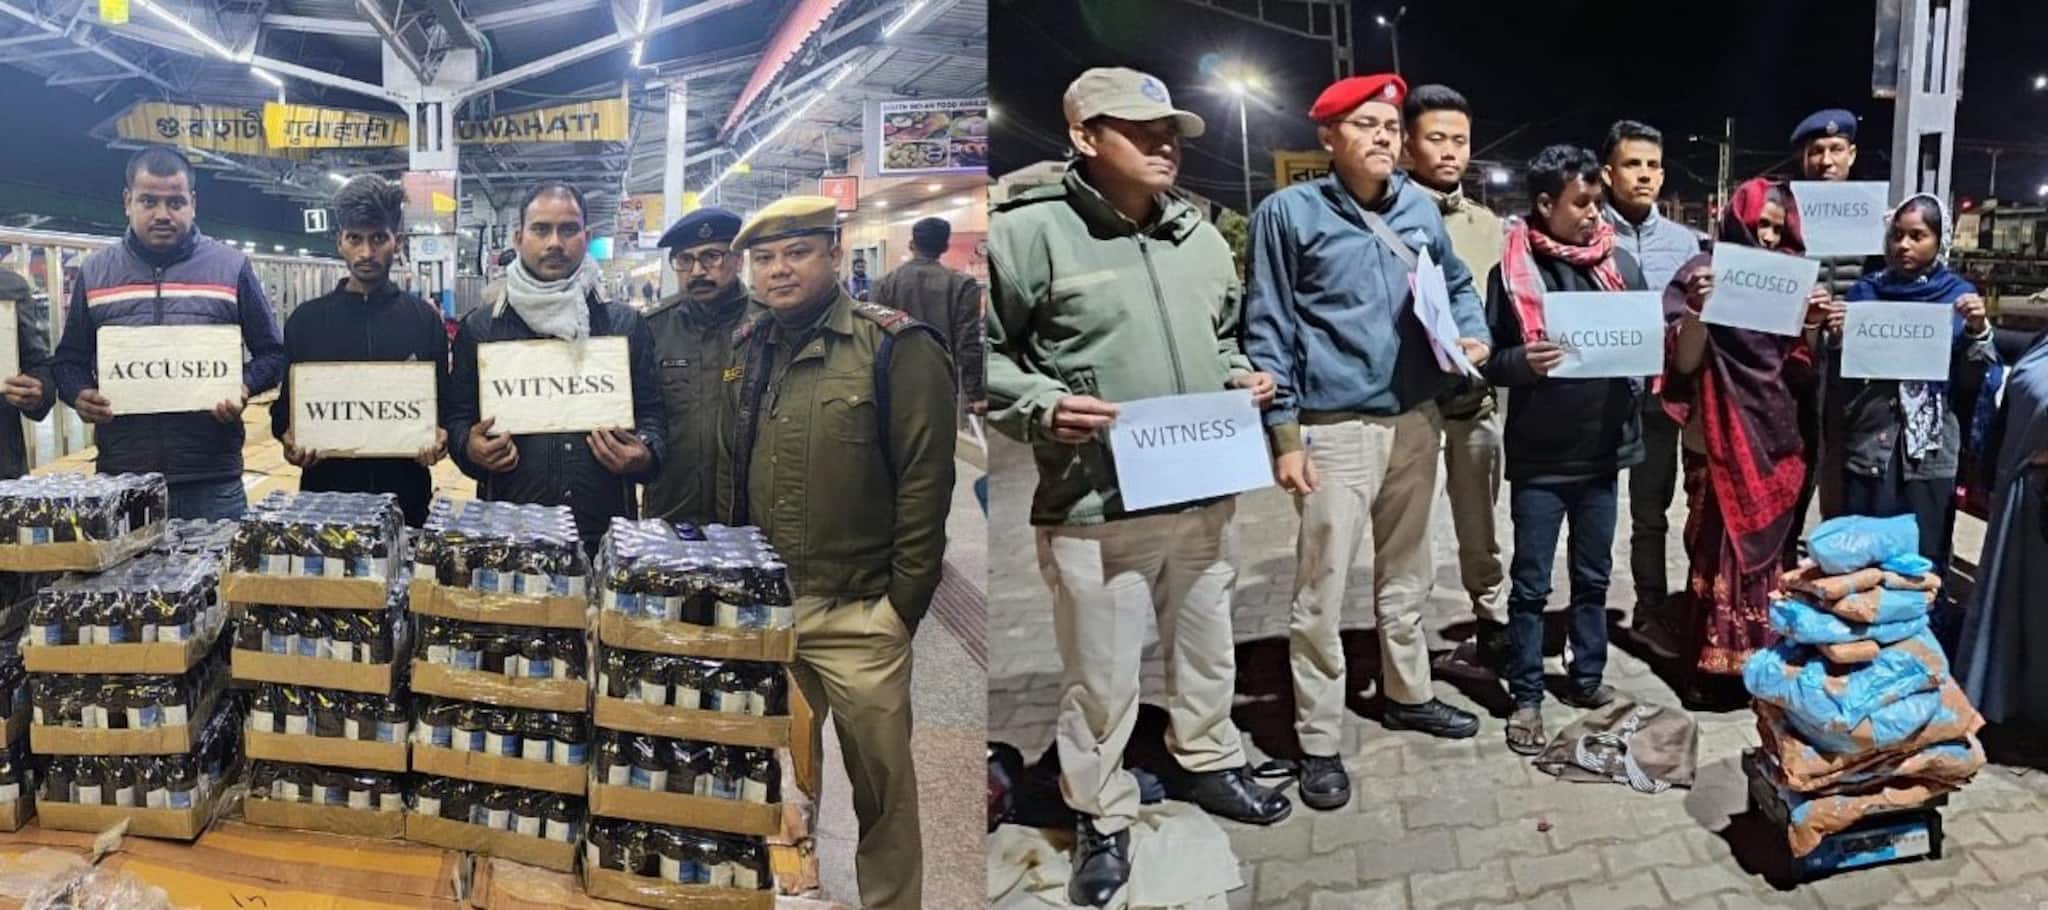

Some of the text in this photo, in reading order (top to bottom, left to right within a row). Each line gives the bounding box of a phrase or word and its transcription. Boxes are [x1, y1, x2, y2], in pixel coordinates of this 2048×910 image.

[458, 111, 600, 140] UWAHATI
[1803, 201, 1869, 217] WITNESS
[1721, 268, 1799, 295] ACCUSED
[1559, 330, 1643, 348] ACCUSED
[1856, 322, 1935, 339] ACCUSED
[109, 360, 228, 379] ACCUSED
[492, 374, 616, 398] WITNESS
[305, 400, 422, 421] WITNESS
[1131, 418, 1237, 449] WITNESS
